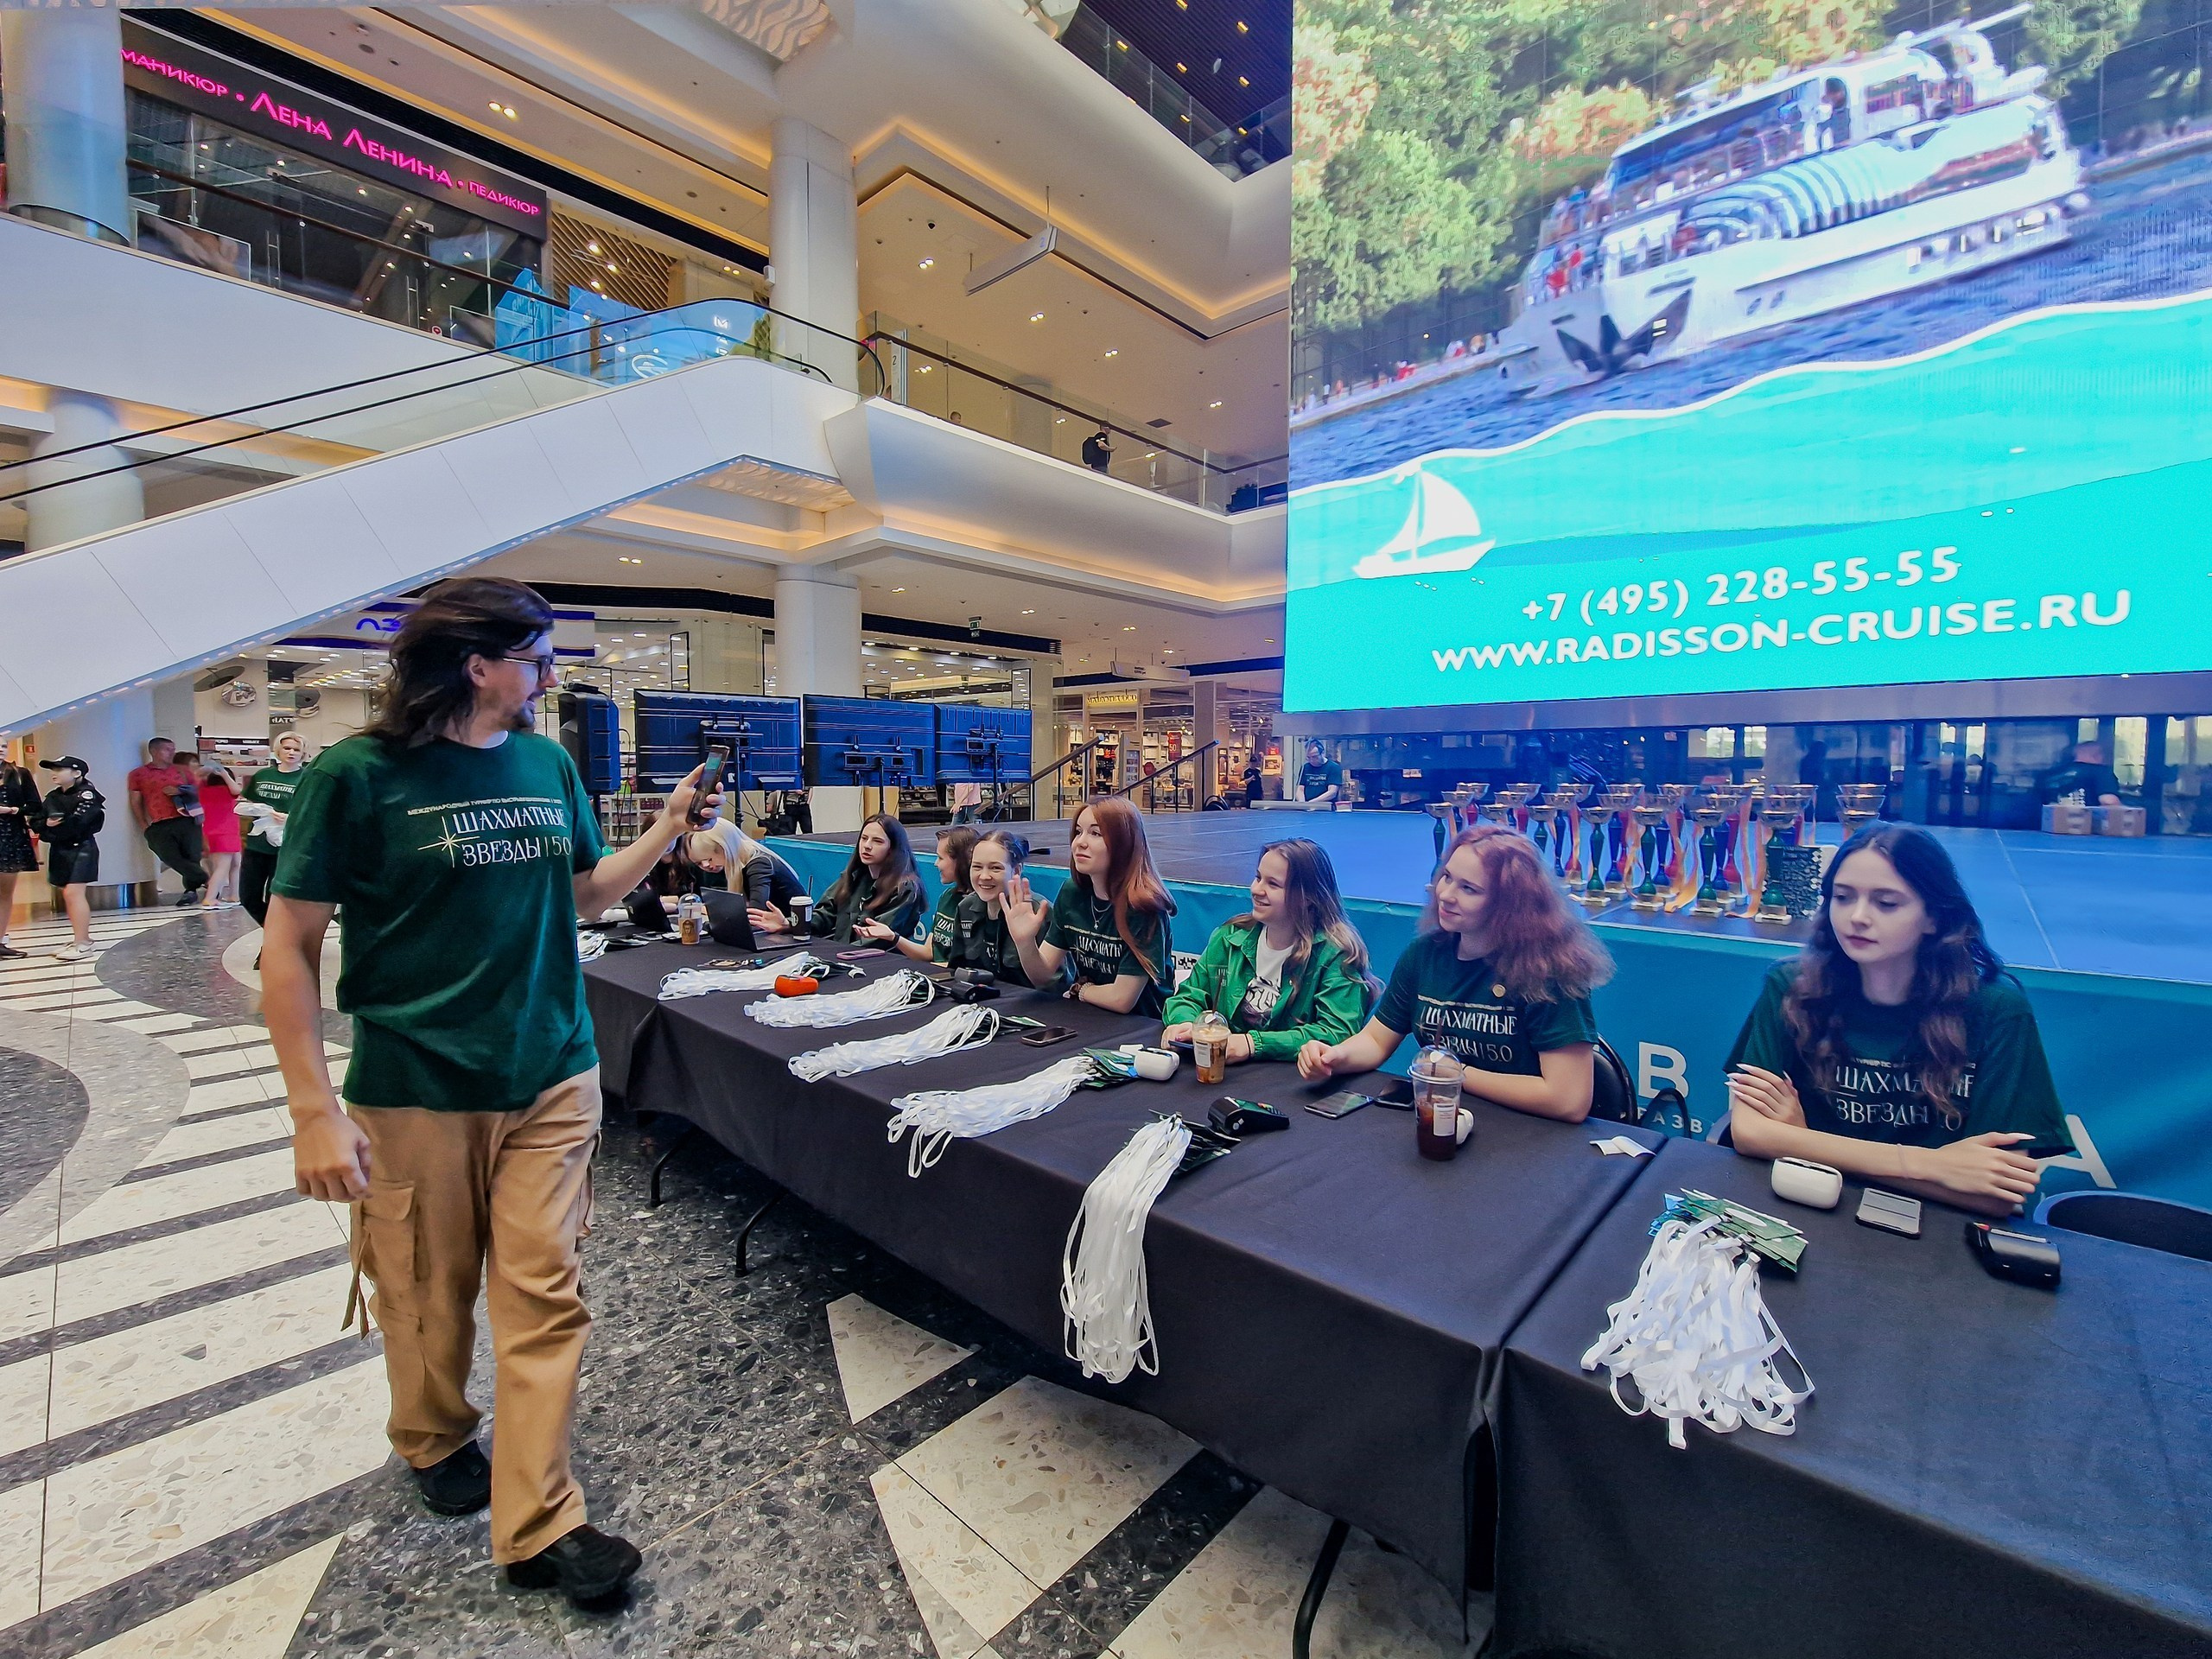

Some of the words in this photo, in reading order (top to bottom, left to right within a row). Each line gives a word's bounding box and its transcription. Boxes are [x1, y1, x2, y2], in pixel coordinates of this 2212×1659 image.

[121, 48, 229, 97] МАНИКЮР
[250, 91, 332, 141] ЛЕНА
[342, 128, 454, 188] ЛЕНИНА
[467, 180, 541, 216] ПЕДИКЮР
[1522, 592, 1567, 621] +7
[1580, 579, 1689, 626] (495)
[1705, 545, 1960, 607] 228-55-55
[1431, 589, 2132, 672] WWW.RADISSON-CRUISE.RU
[452, 806, 567, 835] ШАХМАТНЫЕ
[461, 837, 542, 867] ЗВЕЗДЫ
[1426, 1006, 1518, 1035] ШАХМАТНЫЕ
[1836, 1098, 1929, 1128] ЗВЕЗДЫ
